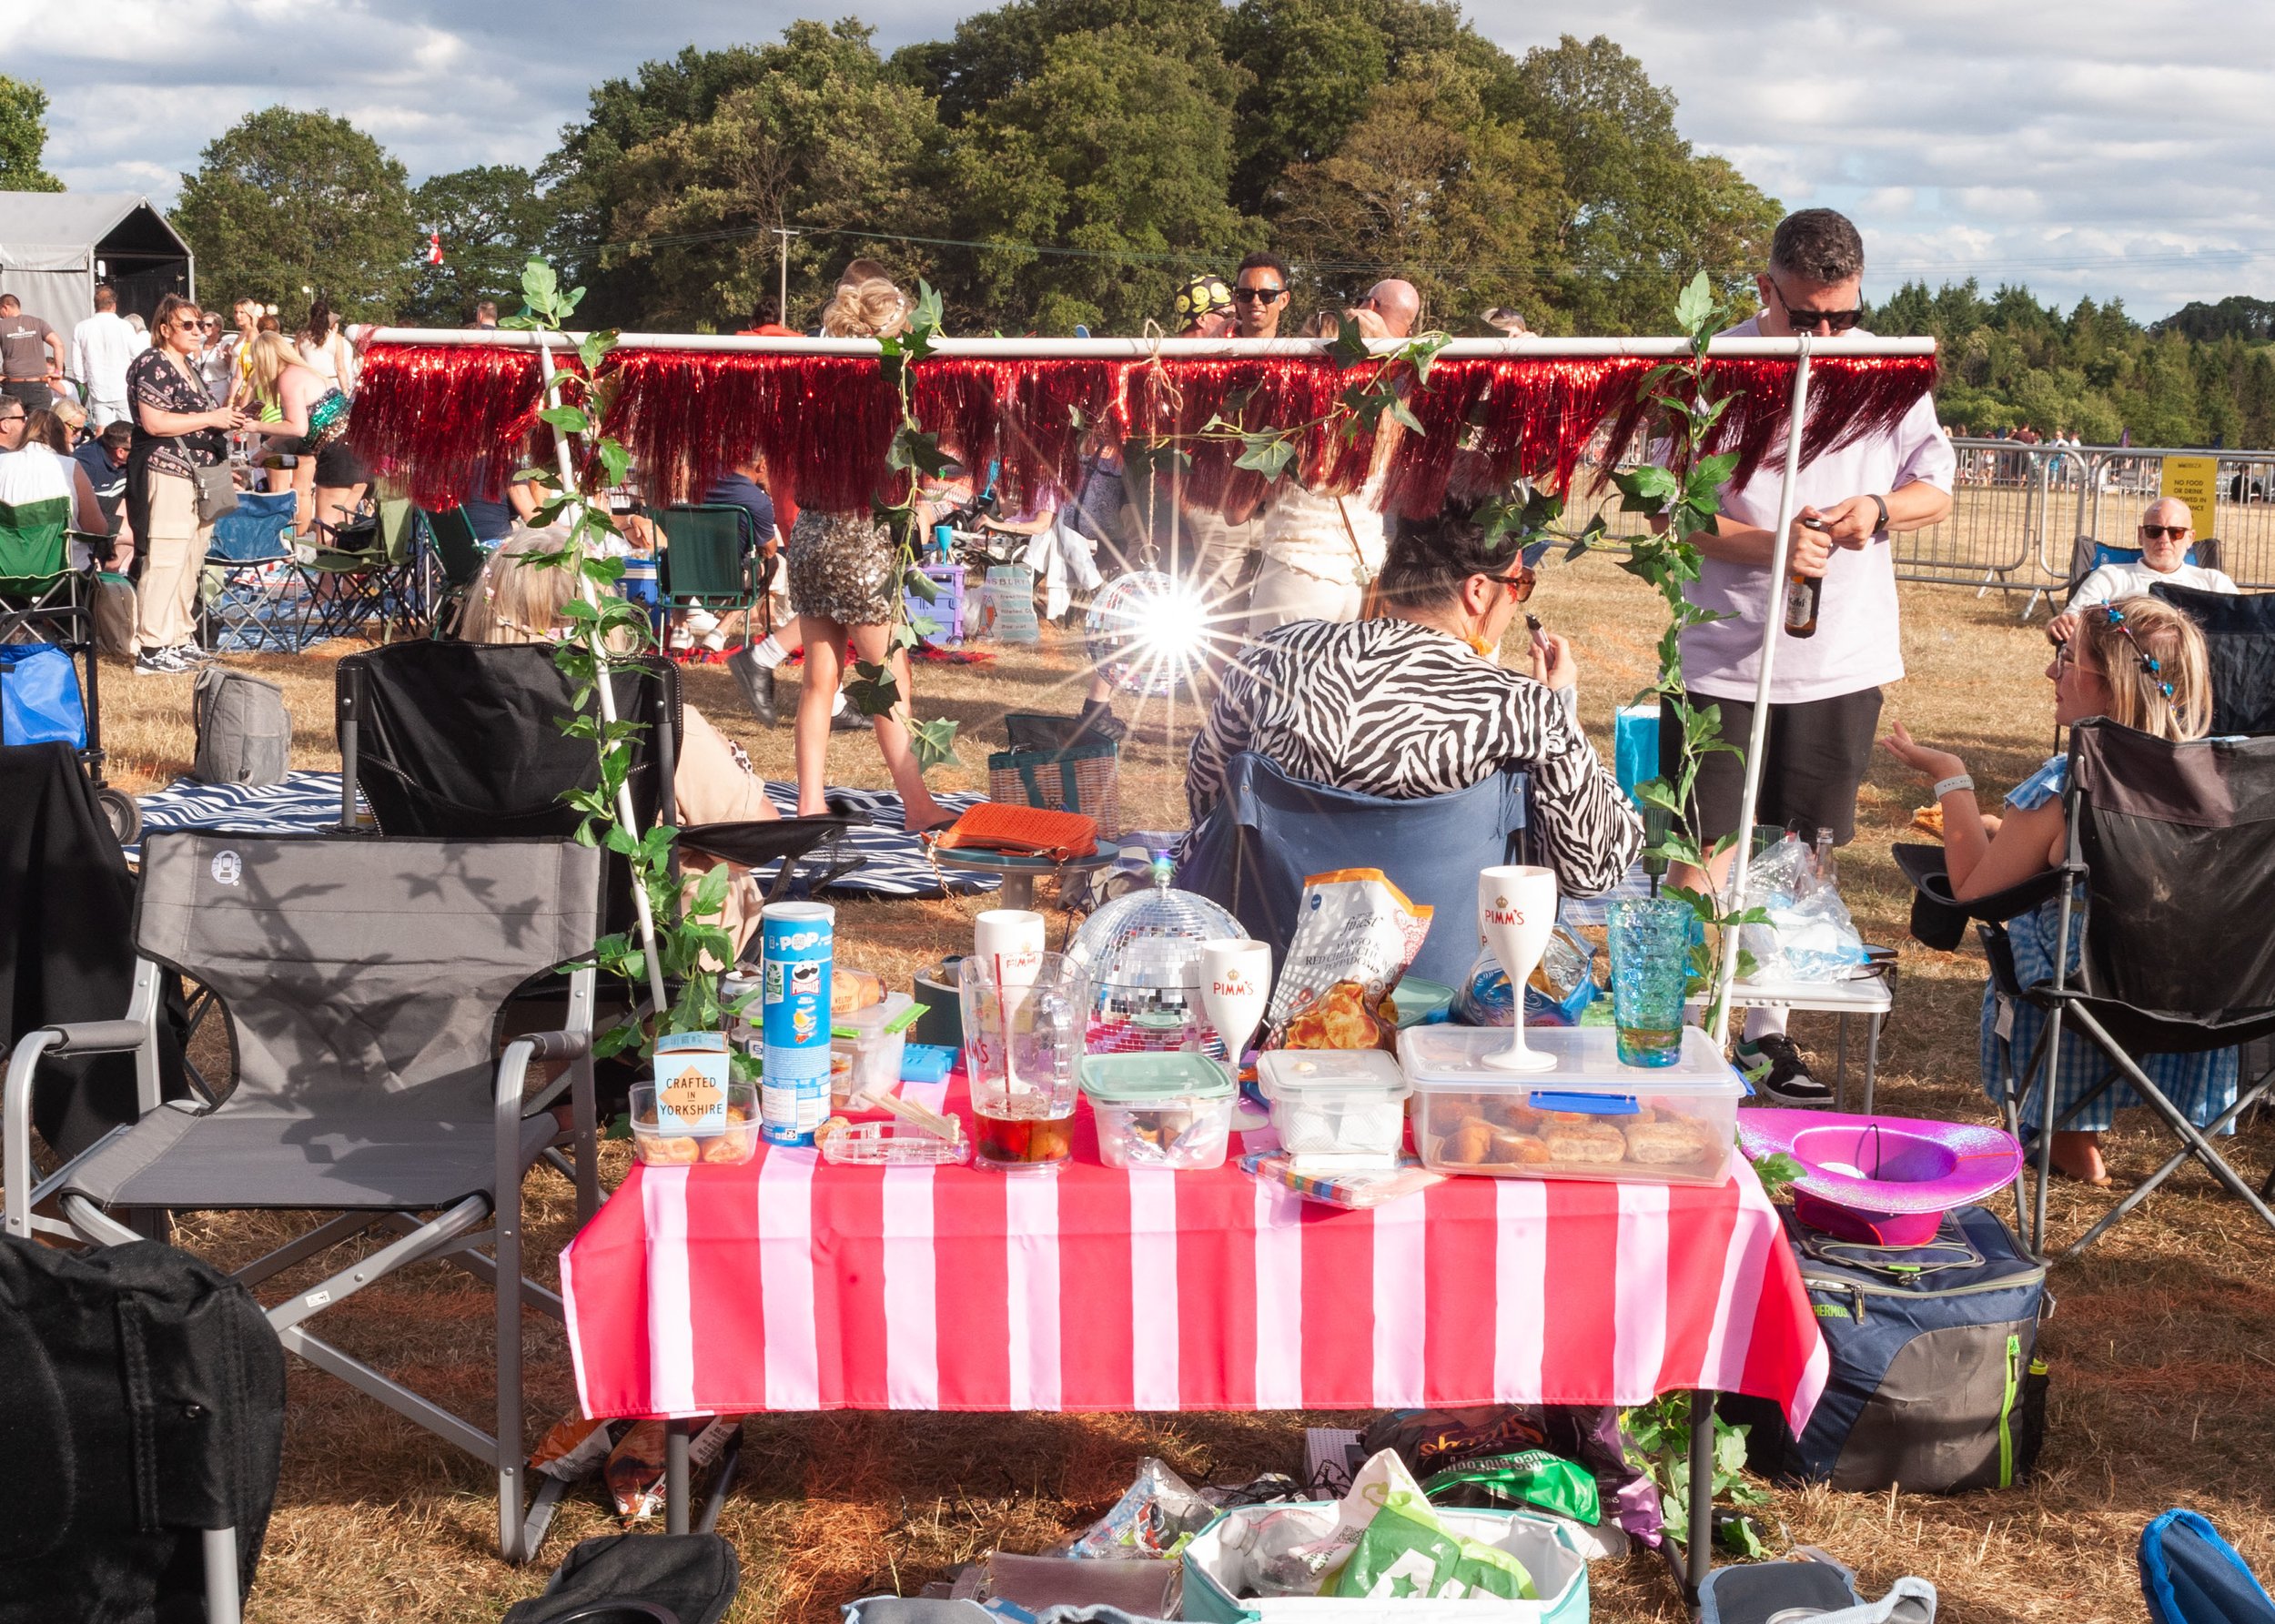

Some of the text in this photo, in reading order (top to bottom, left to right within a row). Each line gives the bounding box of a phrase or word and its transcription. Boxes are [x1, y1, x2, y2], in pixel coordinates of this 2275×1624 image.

[1485, 909, 1525, 925] PIMM'S
[1337, 937, 1371, 951] MANGO
[1305, 955, 1326, 965] RED
[1213, 981, 1254, 996] PIMM'S
[666, 1077, 716, 1089] CRAFTED
[660, 1104, 723, 1115] YORKSHIRE
